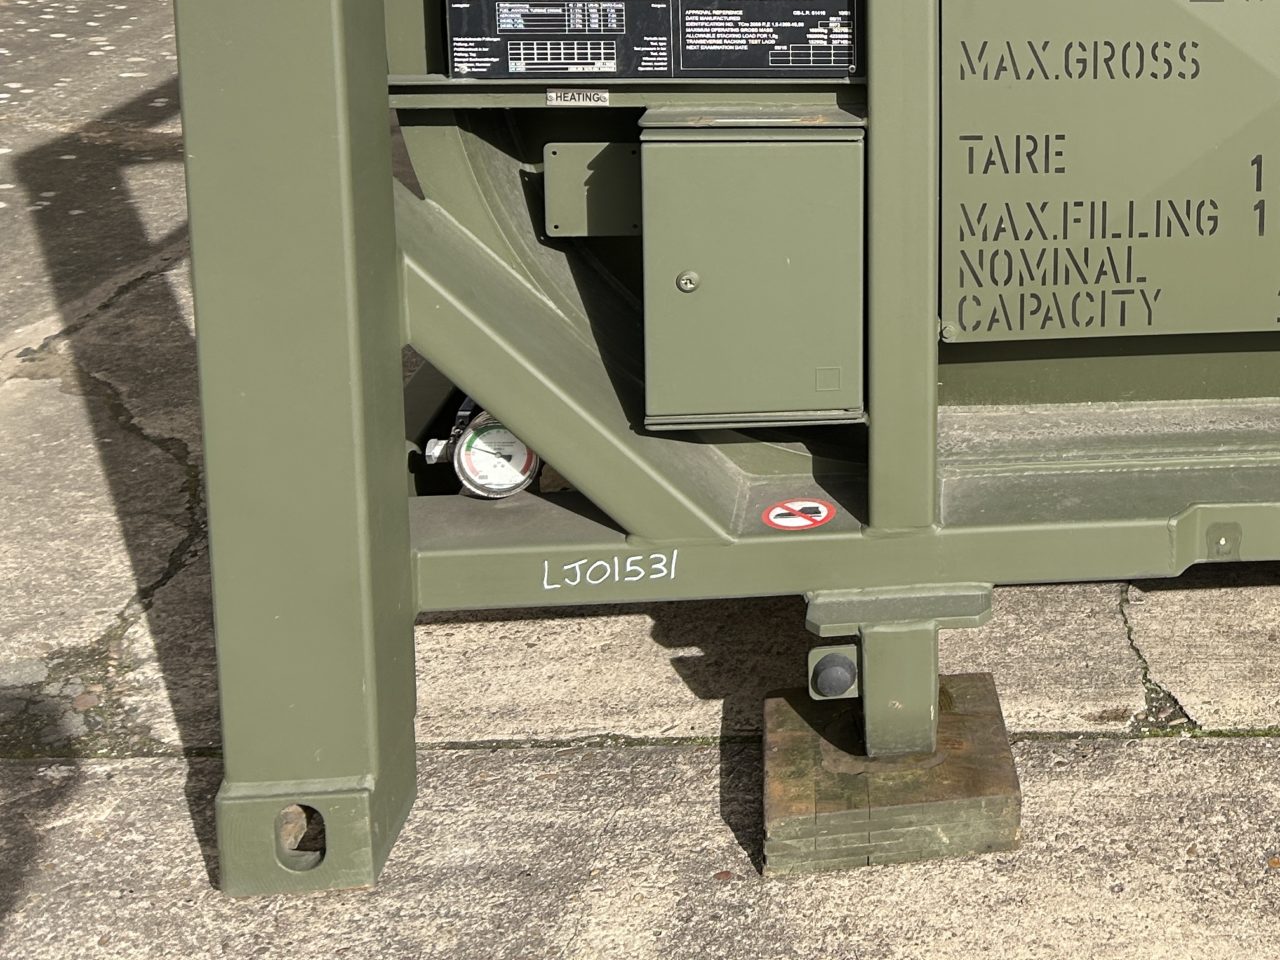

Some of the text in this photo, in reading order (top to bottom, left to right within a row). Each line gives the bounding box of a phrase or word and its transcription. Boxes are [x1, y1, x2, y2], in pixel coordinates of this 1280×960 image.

[555, 92, 600, 103] HEATING
[959, 134, 1066, 175] TARE
[959, 245, 1147, 288] NOMINAL
[957, 288, 1162, 332] CAPACITY
